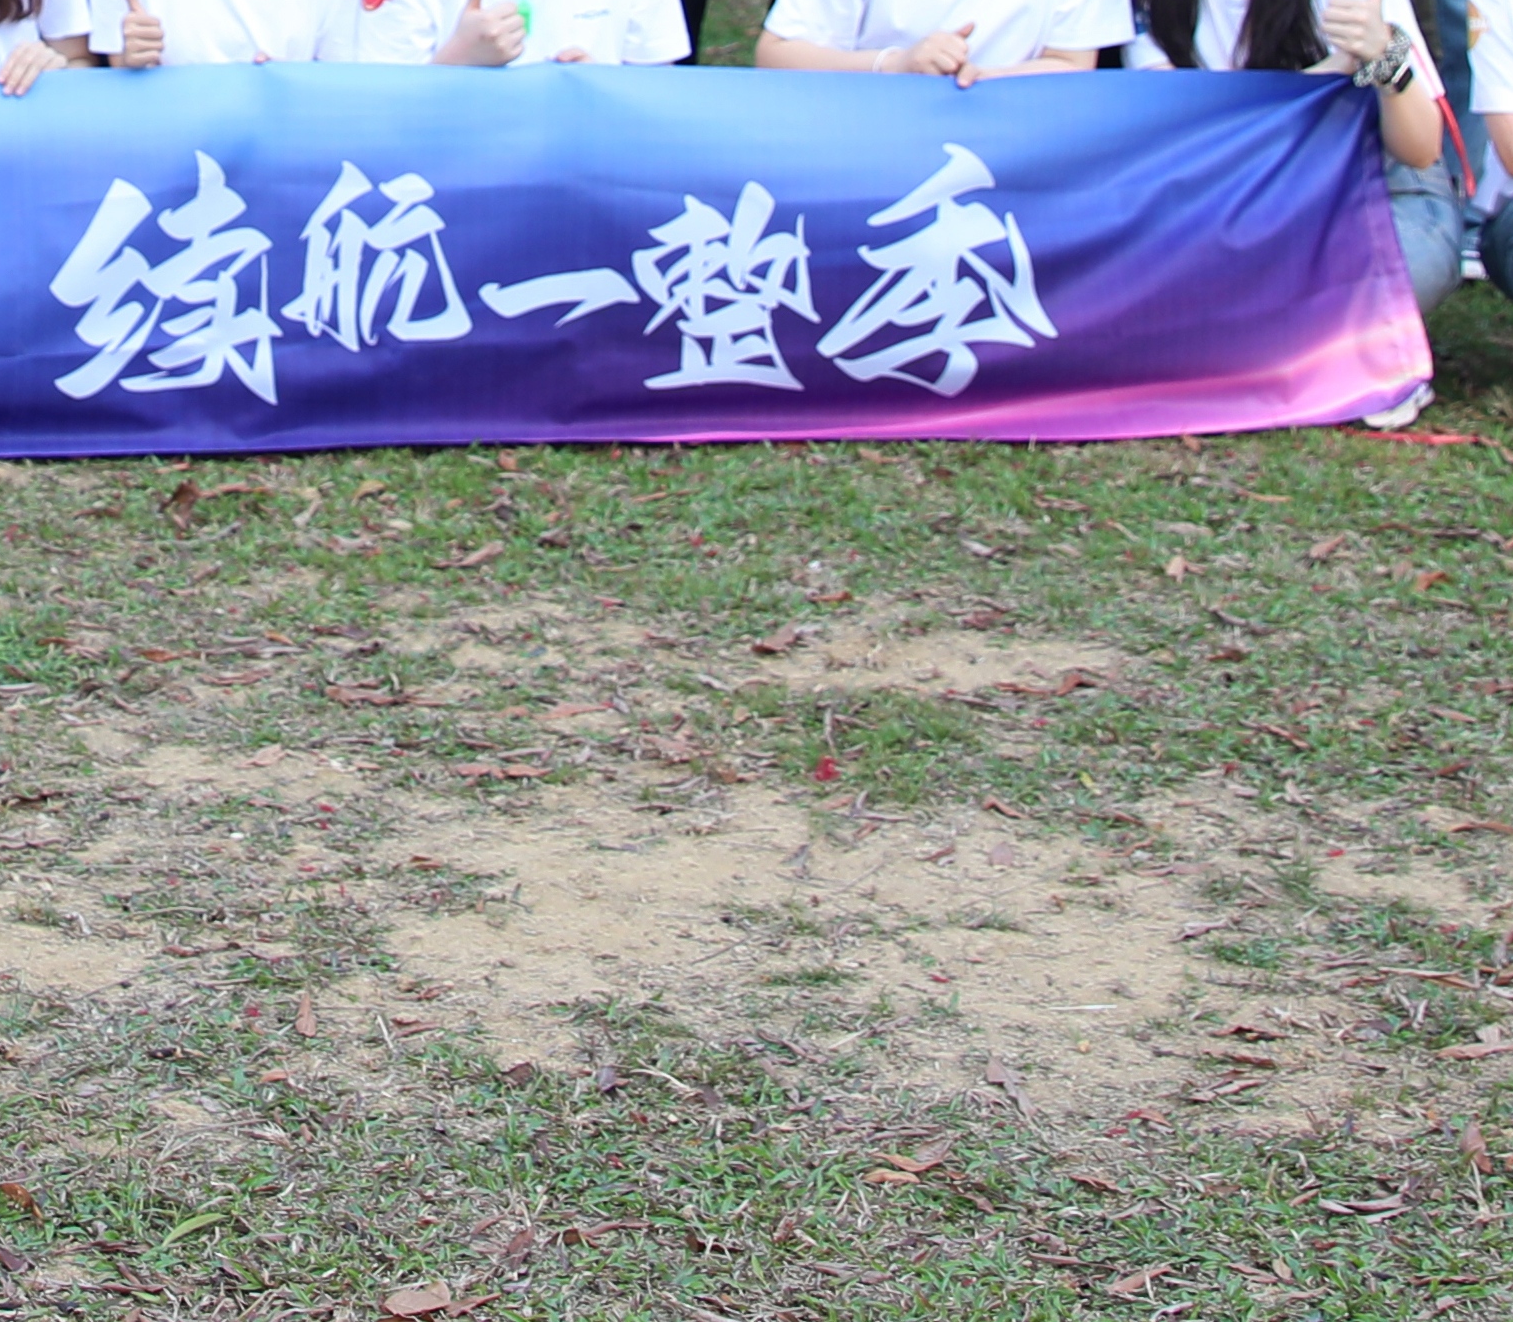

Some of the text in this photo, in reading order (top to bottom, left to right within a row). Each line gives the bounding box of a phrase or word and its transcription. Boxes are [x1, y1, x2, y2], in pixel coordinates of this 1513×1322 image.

[48, 142, 1059, 406] 续航一整季
